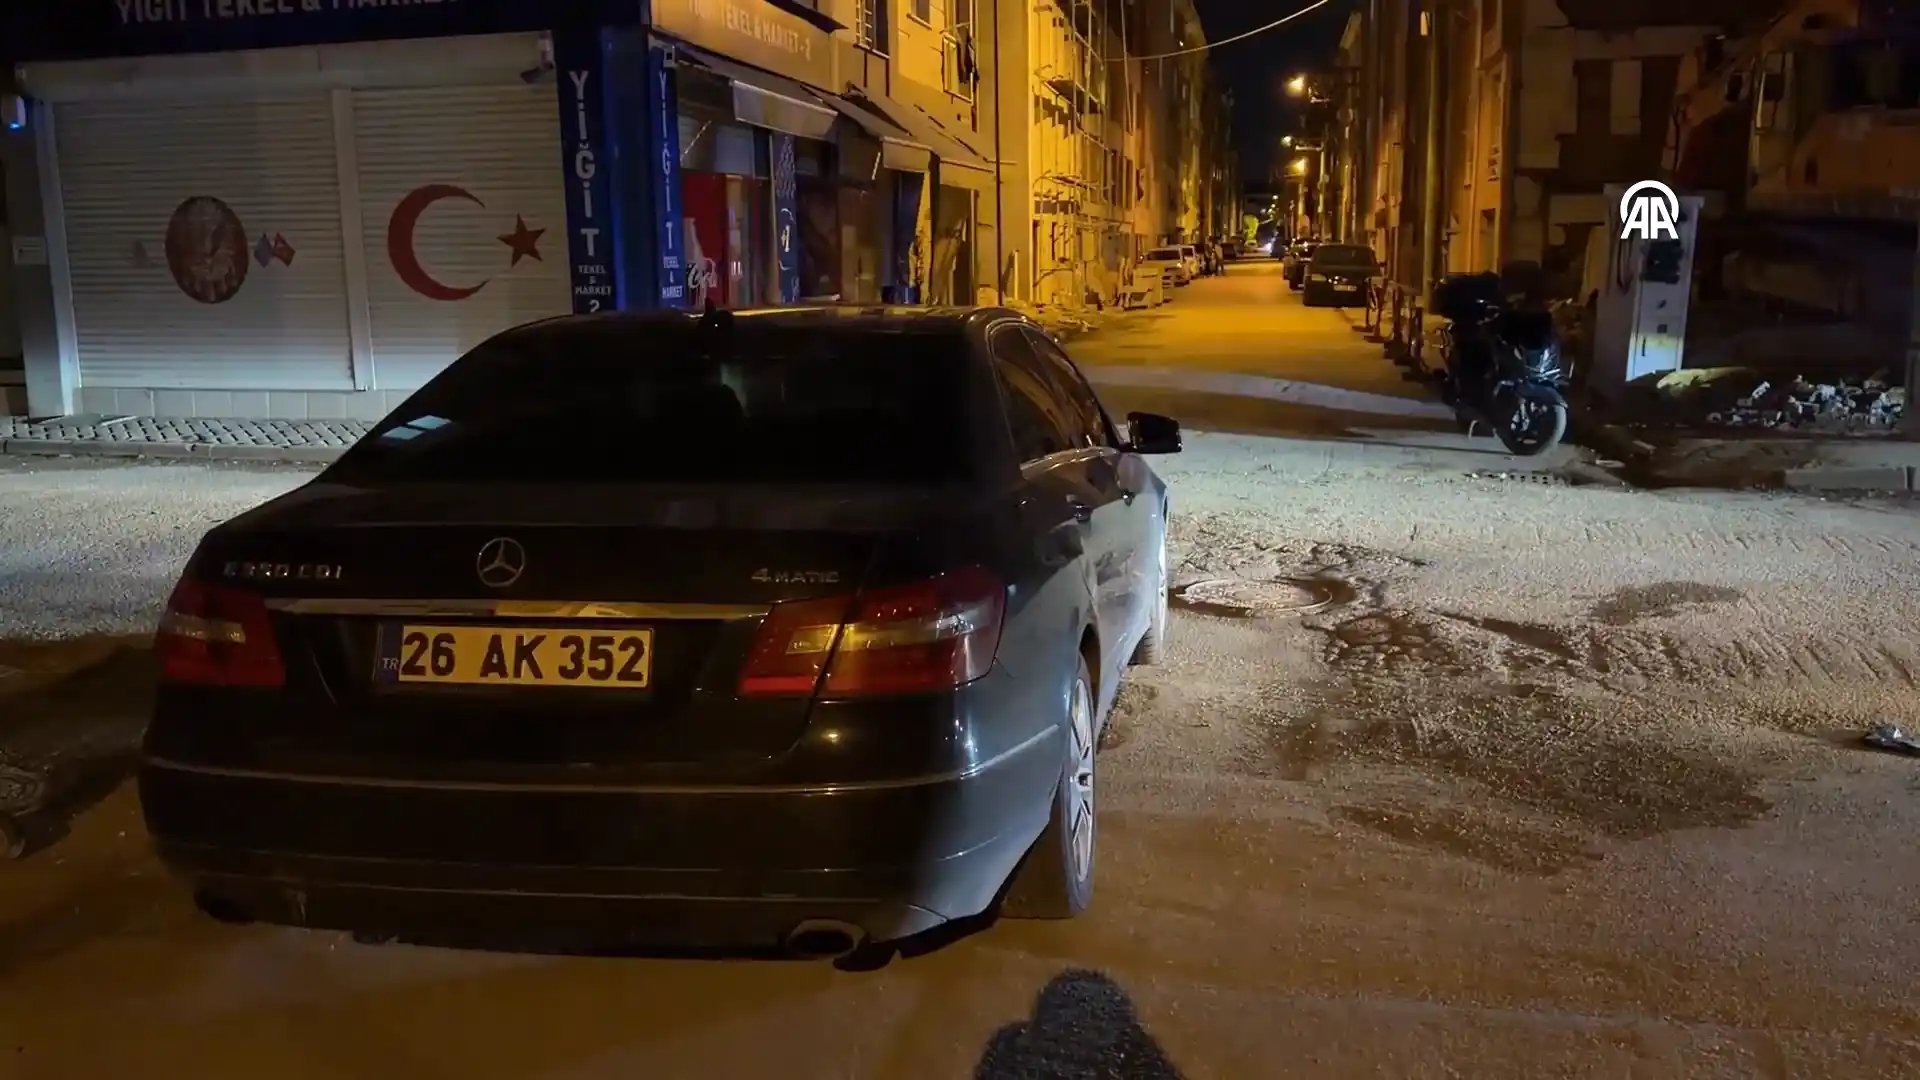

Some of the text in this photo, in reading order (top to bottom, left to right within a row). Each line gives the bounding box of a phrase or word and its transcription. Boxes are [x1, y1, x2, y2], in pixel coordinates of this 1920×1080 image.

[577, 265, 607, 274] TEKEL
[574, 286, 612, 297] MARKET
[401, 632, 646, 681] 26 AK 352
[381, 656, 399, 671] TR
